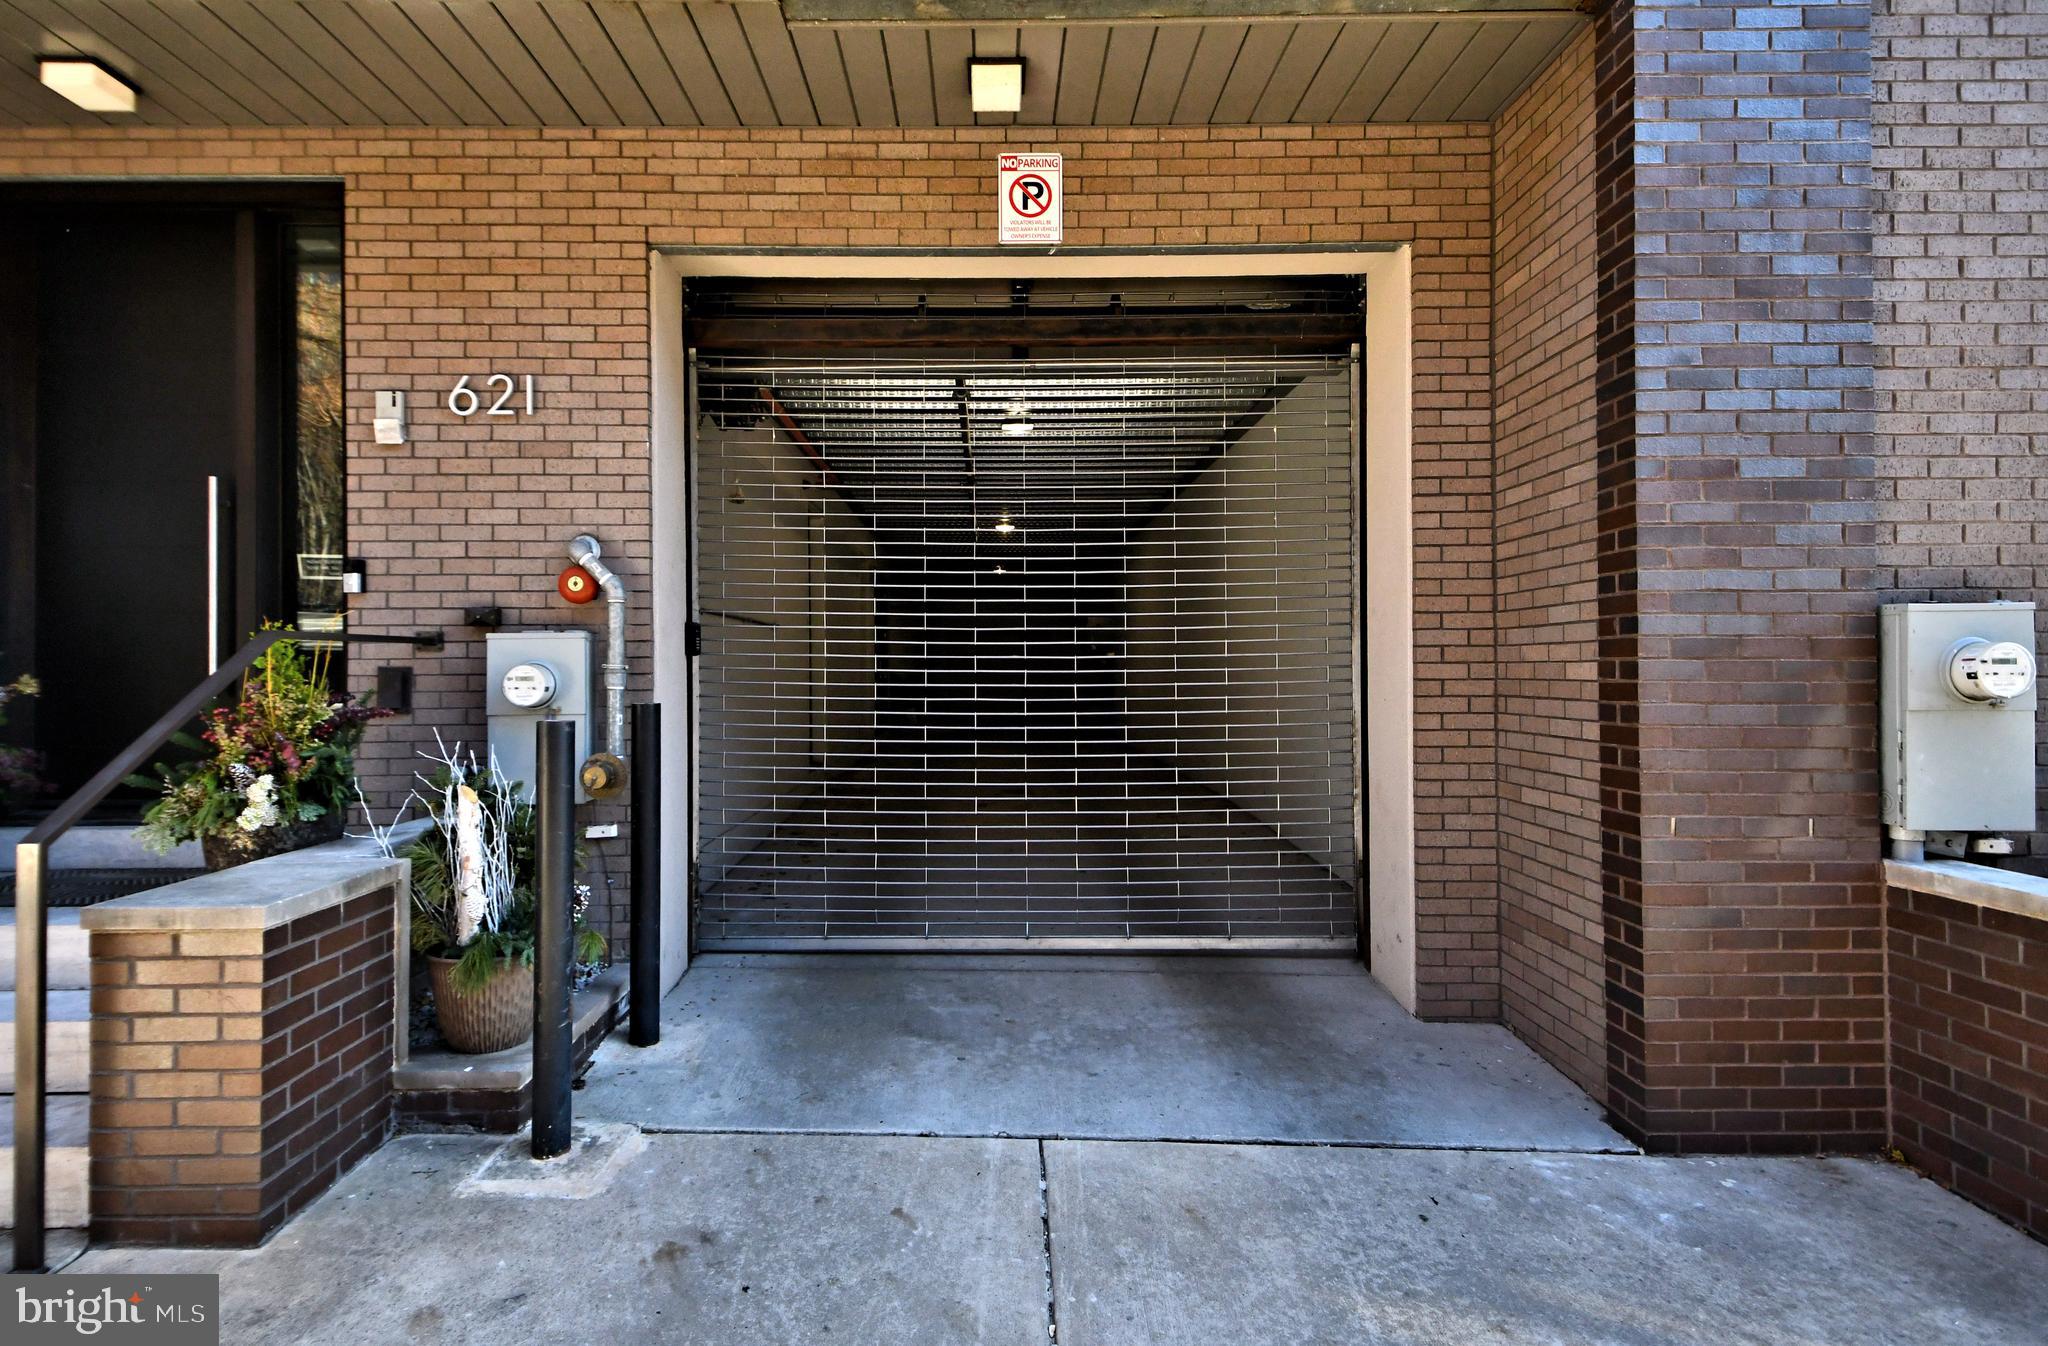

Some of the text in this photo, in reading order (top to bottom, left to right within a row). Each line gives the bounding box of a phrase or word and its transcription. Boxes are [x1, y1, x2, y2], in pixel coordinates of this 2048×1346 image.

[1002, 158, 1058, 168] NO PARKING
[448, 374, 534, 416] 621
